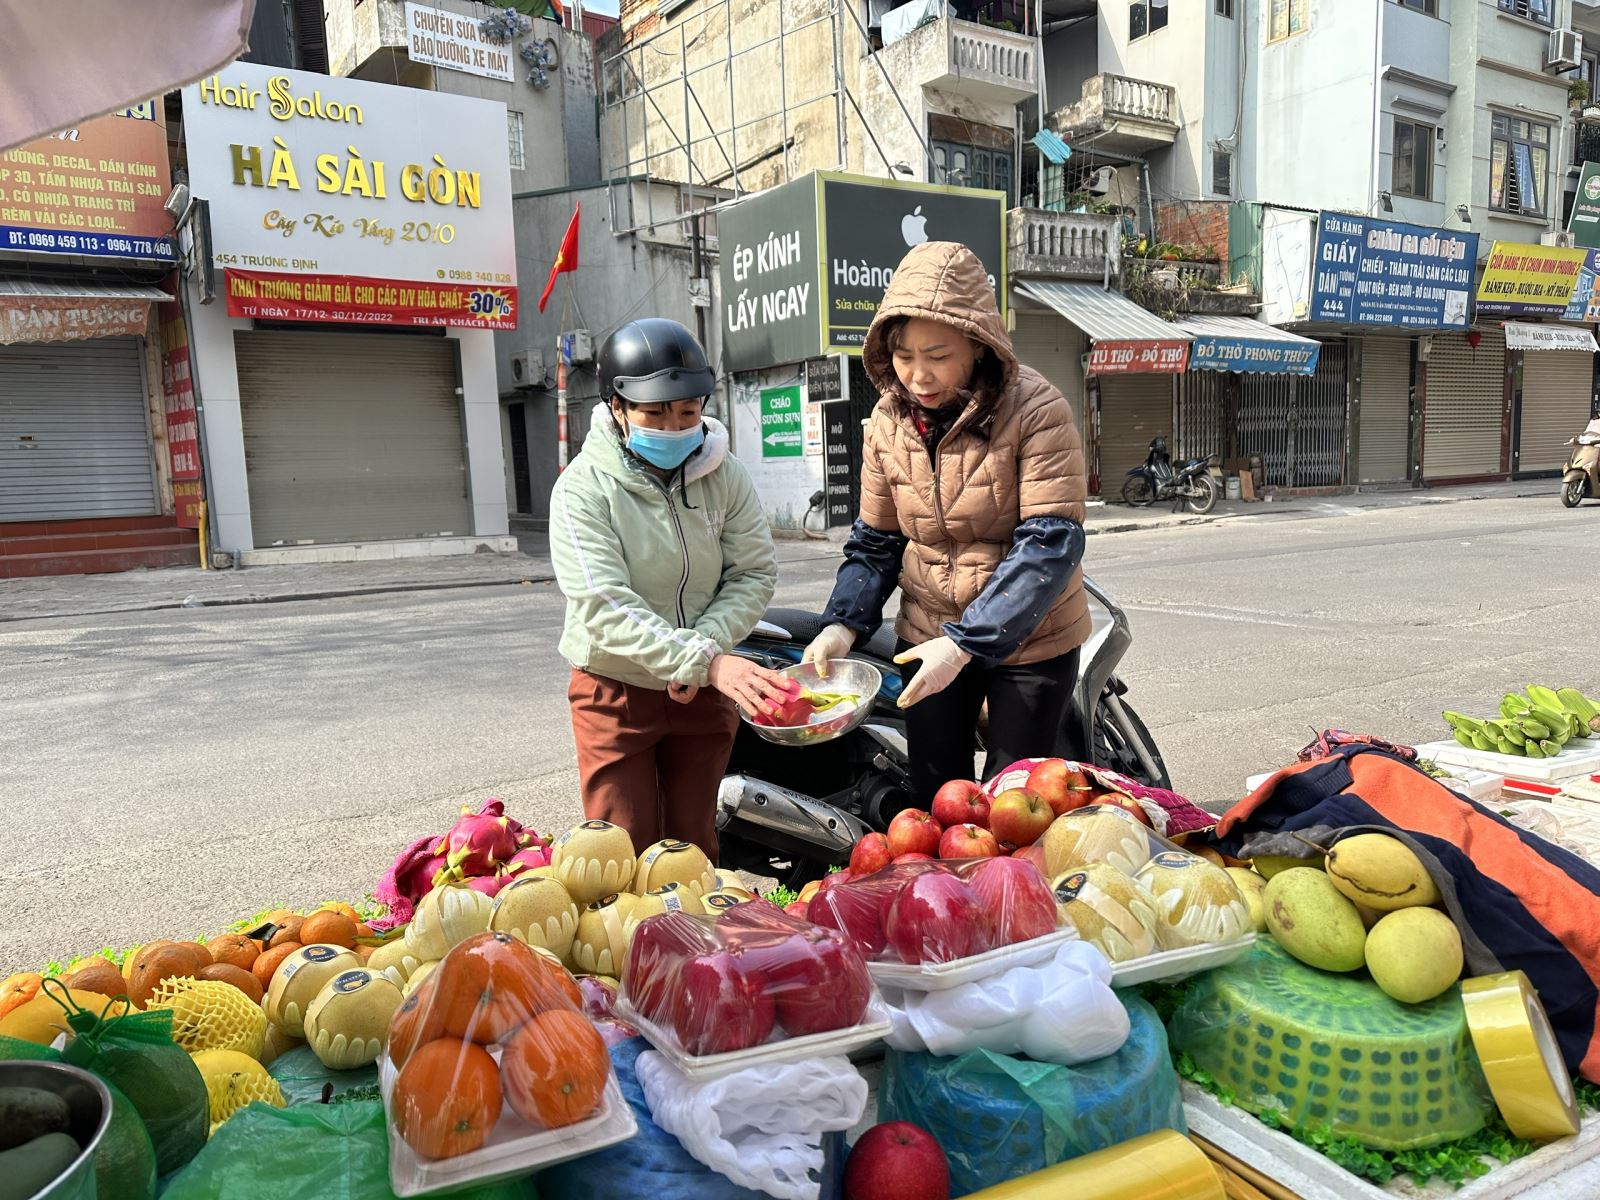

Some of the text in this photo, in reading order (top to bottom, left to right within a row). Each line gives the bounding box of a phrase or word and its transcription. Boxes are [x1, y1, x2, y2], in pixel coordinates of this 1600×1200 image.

[414, 10, 453, 36] CHUYÊN
[456, 17, 476, 40] SỬA
[413, 32, 433, 56] BẢO
[436, 39, 470, 64] DƯỠNG
[473, 48, 485, 68] XE
[488, 48, 508, 72] MÁY
[200, 74, 363, 124] Hair Salon
[53, 154, 96, 172] DECAL,
[100, 158, 125, 174] DÁN
[128, 161, 156, 178] KÍNH
[230, 135, 481, 208] HÀ SÀI GÒN
[14, 170, 35, 185] 3D,
[38, 170, 66, 187] TẤM
[70, 176, 104, 194] NHỰA
[107, 176, 134, 194] TRẢI
[137, 181, 162, 196] SÀN
[13, 185, 31, 203] CỎ
[34, 191, 70, 210] NHỰA
[73, 194, 114, 210] TRANG
[116, 198, 136, 212] TRÍ
[2, 206, 126, 231] RÈM VẢI CÁC LOẠI...
[263, 209, 298, 238] Cây
[303, 213, 345, 238] Kéo
[401, 220, 456, 244] 2010
[1326, 218, 1362, 234] CỬA HÀNG
[9, 232, 26, 244] ĐT:
[29, 233, 55, 248] 0969
[58, 235, 76, 248] 459
[79, 237, 98, 250] 113
[107, 239, 131, 252] 0964
[133, 241, 152, 254] 778
[1323, 239, 1357, 263] GIẤY
[1367, 228, 1465, 262] CHĂN GA GỐI ĐỆM
[216, 254, 318, 270] 454 TRƯƠNG ĐỊNH
[733, 230, 800, 282] ÉP KÍNH
[449, 270, 472, 280] 0988
[495, 273, 511, 283] 828
[1318, 268, 1337, 293] DÁN
[1362, 256, 1469, 286] CHIẾU THẢM TRẢI SÀN CÁC LOẠI
[230, 278, 510, 314] KHAI TRƯƠNG GIẢM GIÁ CHO CÁC D/V HÓA CHẤT 30%
[1358, 280, 1371, 296] QUẠT
[1372, 280, 1385, 297] ĐIỆN
[1423, 287, 1431, 299] GIA
[1432, 288, 1445, 302] DỤNG
[1484, 278, 1503, 293] BÁNH
[1502, 282, 1514, 297] KẸO
[1532, 284, 1543, 296] BIA
[728, 282, 810, 332] LẤY NGAY
[836, 299, 852, 310] Sửa
[854, 299, 874, 310] chữa
[1324, 300, 1343, 311] 444
[242, 306, 256, 315] TỪ
[261, 306, 290, 317] NGÀY
[332, 311, 393, 322] 30/12/2022
[413, 317, 429, 325] TRI
[432, 317, 446, 325] ÂN
[450, 318, 485, 328] KHÁCH
[488, 319, 516, 329] HÀNG
[1093, 345, 1108, 363] TỦ
[1111, 346, 1135, 363] THỜ
[1161, 345, 1184, 363] THỜ
[1197, 339, 1216, 357] ĐỒ
[1218, 343, 1243, 359] THỜ
[1245, 347, 1281, 361] PHONG
[770, 396, 791, 408] CHÁO
[762, 412, 800, 425] SƯỜN SỤN
[831, 422, 843, 434] MỞ
[828, 444, 847, 454] KHÓA
[828, 485, 850, 494] IPHONE
[832, 504, 848, 514] IPAD
